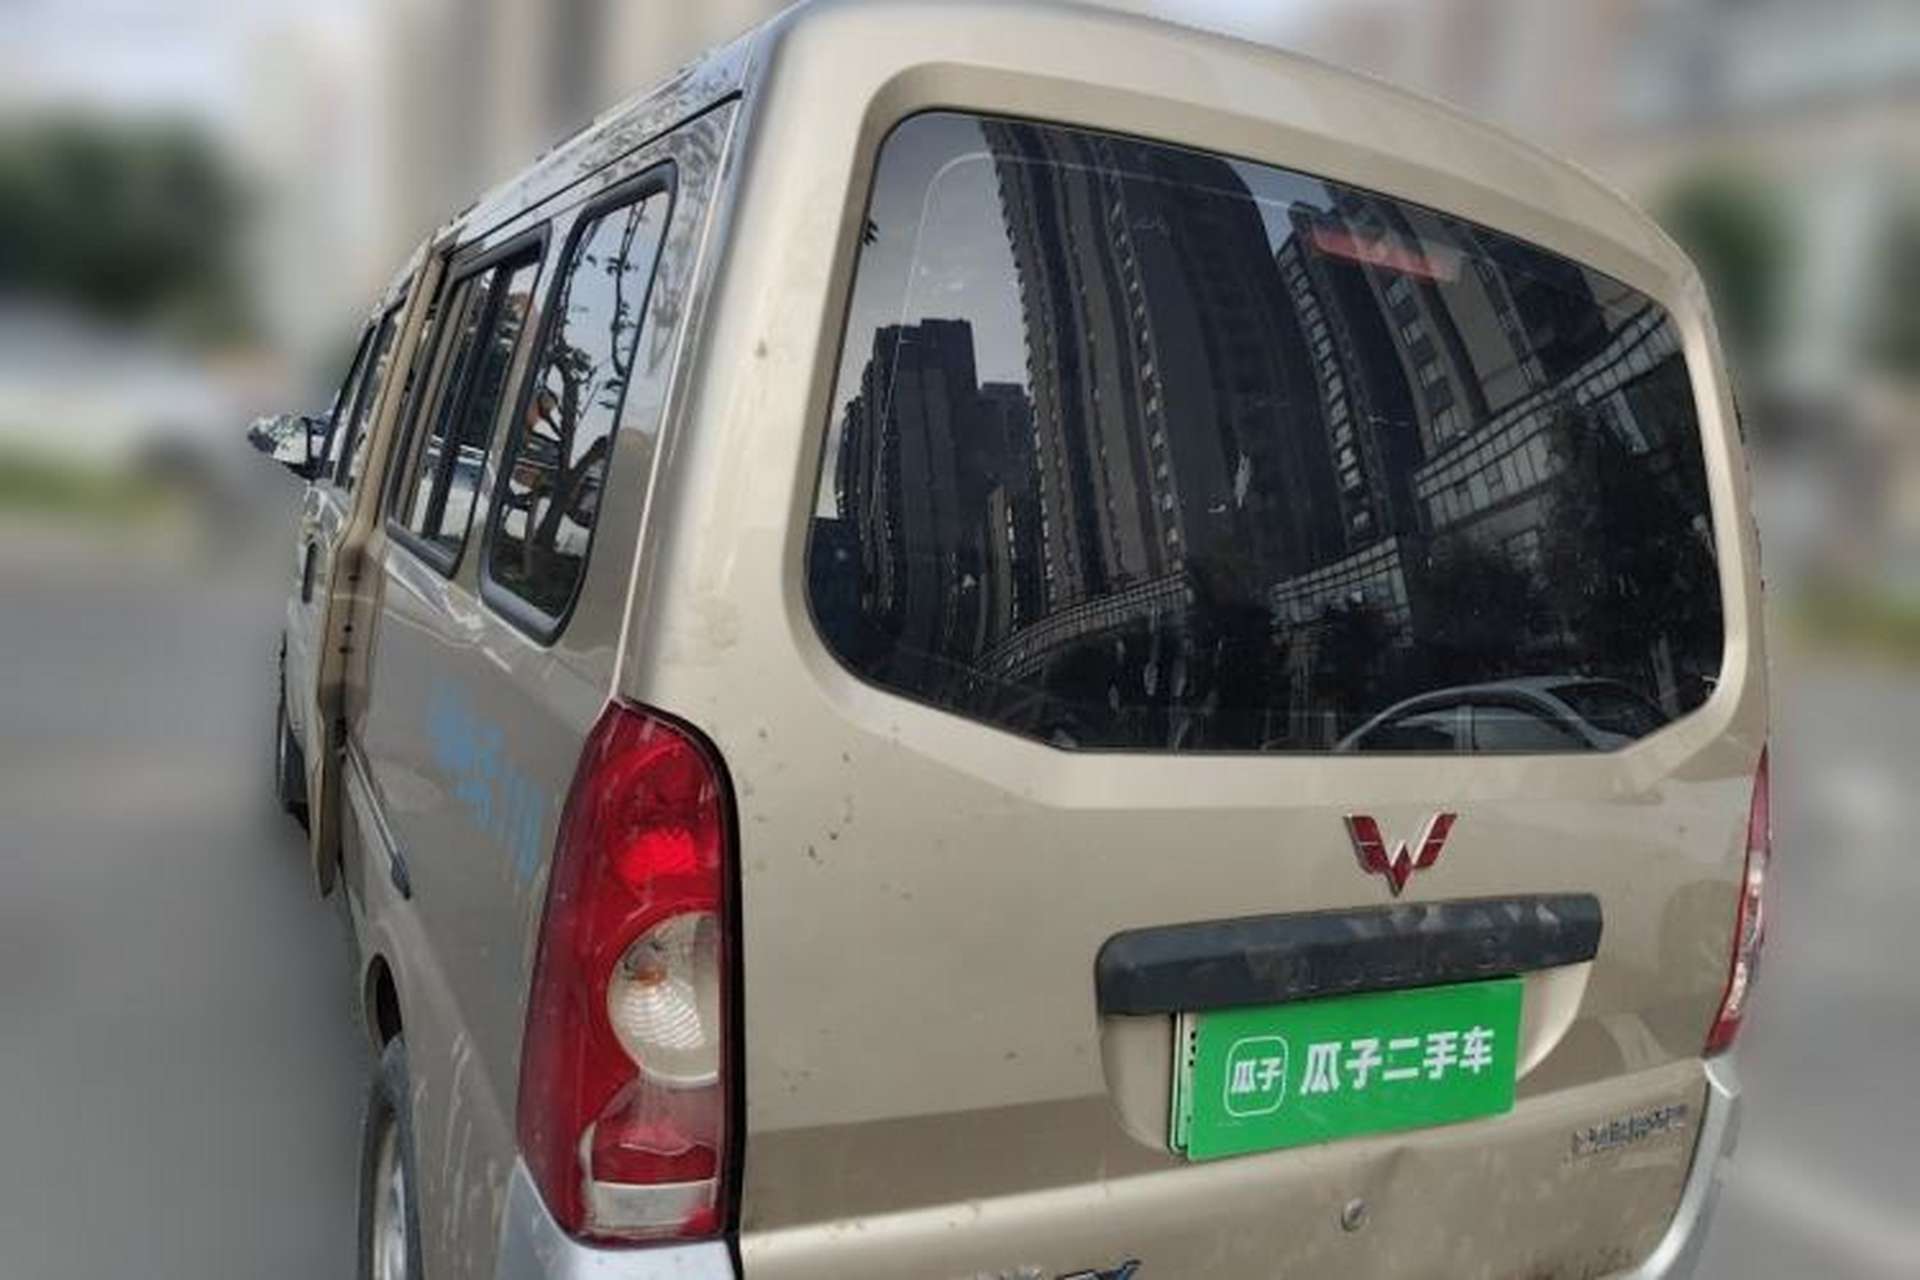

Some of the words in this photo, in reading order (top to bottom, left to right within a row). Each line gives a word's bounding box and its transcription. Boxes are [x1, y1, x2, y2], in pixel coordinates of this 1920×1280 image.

[1231, 1057, 1283, 1093] 瓜子
[1300, 1026, 1494, 1095] 瓜子二手车
